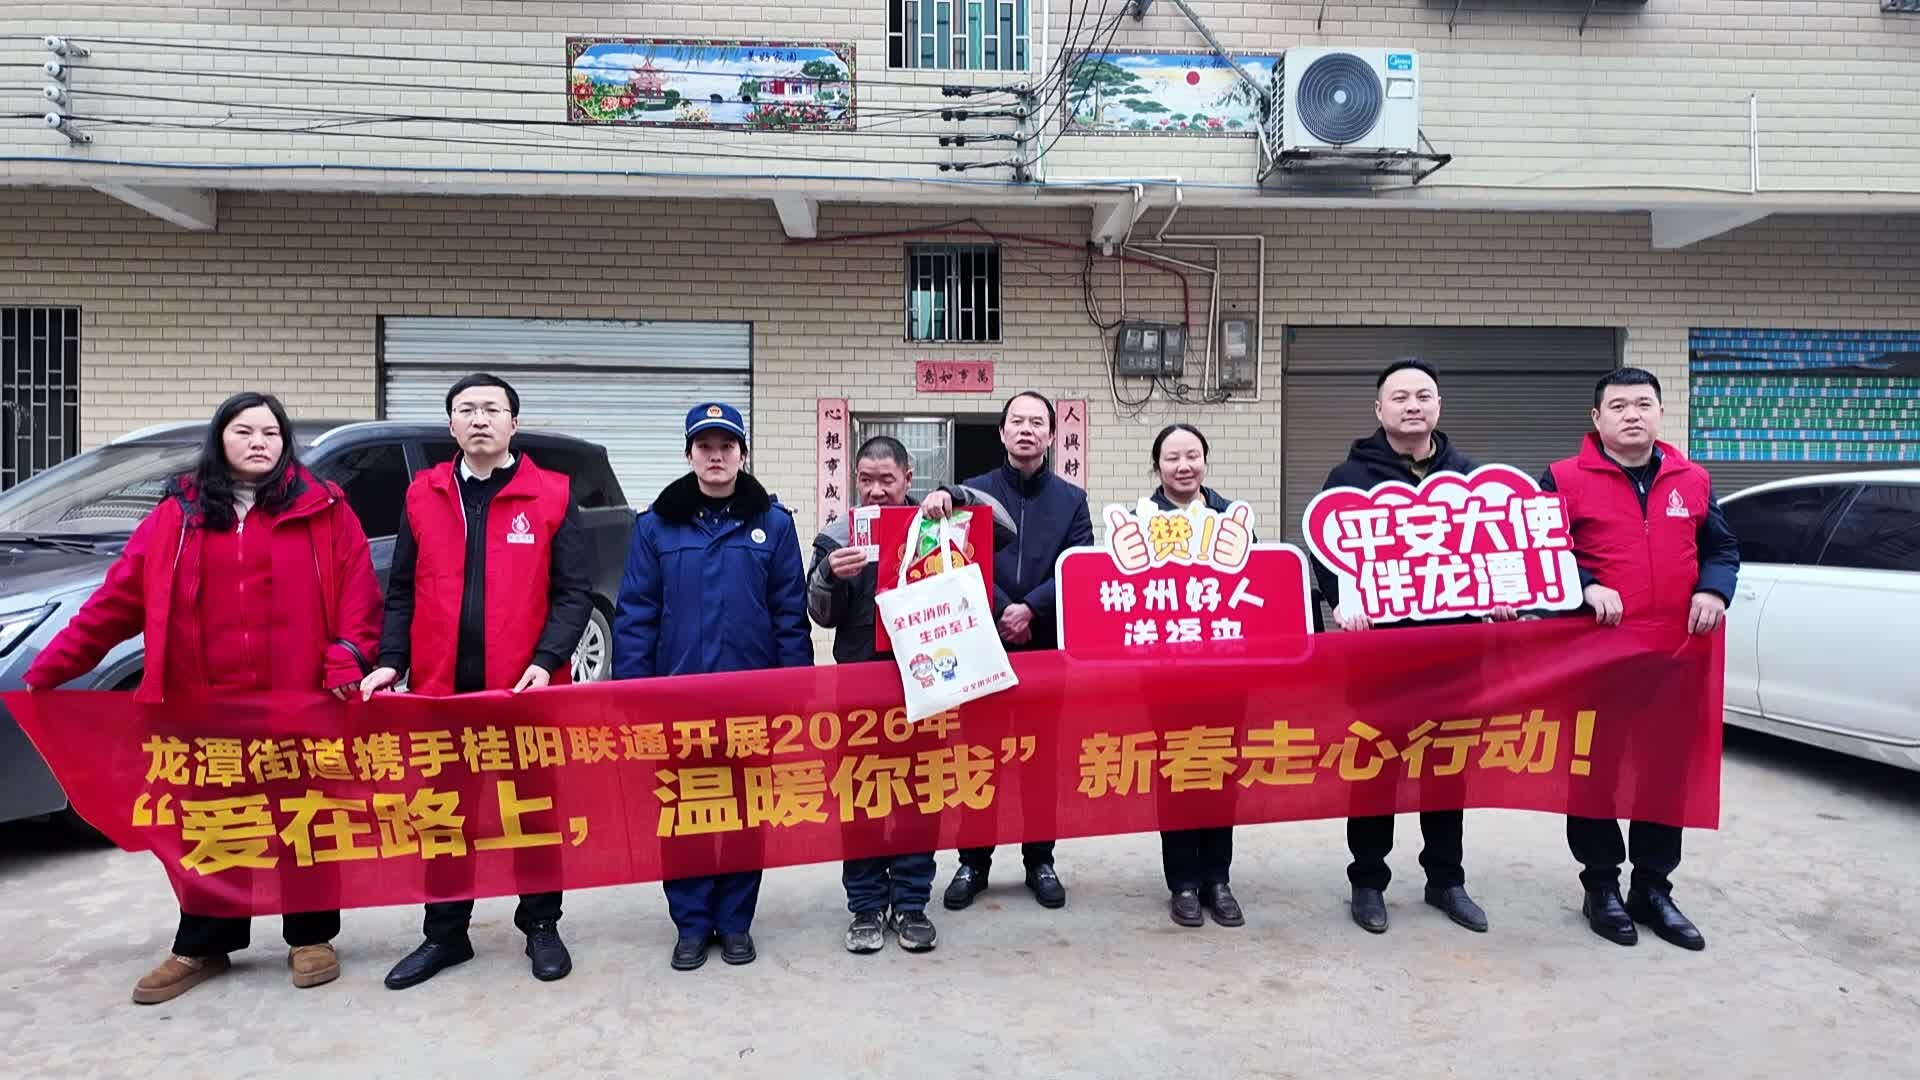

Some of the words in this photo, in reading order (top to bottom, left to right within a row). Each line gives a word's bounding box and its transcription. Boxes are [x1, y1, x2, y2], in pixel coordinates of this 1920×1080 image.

[1147, 513, 1216, 562] 赞！
[1338, 496, 1568, 560] 平安大使
[1099, 576, 1265, 613] 郴州好人
[1359, 550, 1560, 615] 伴龙潭！
[893, 602, 951, 632] 全民消防
[919, 615, 979, 645] 生命至上
[141, 705, 962, 788] 龙潭街道携手桂阳联通开展2026年
